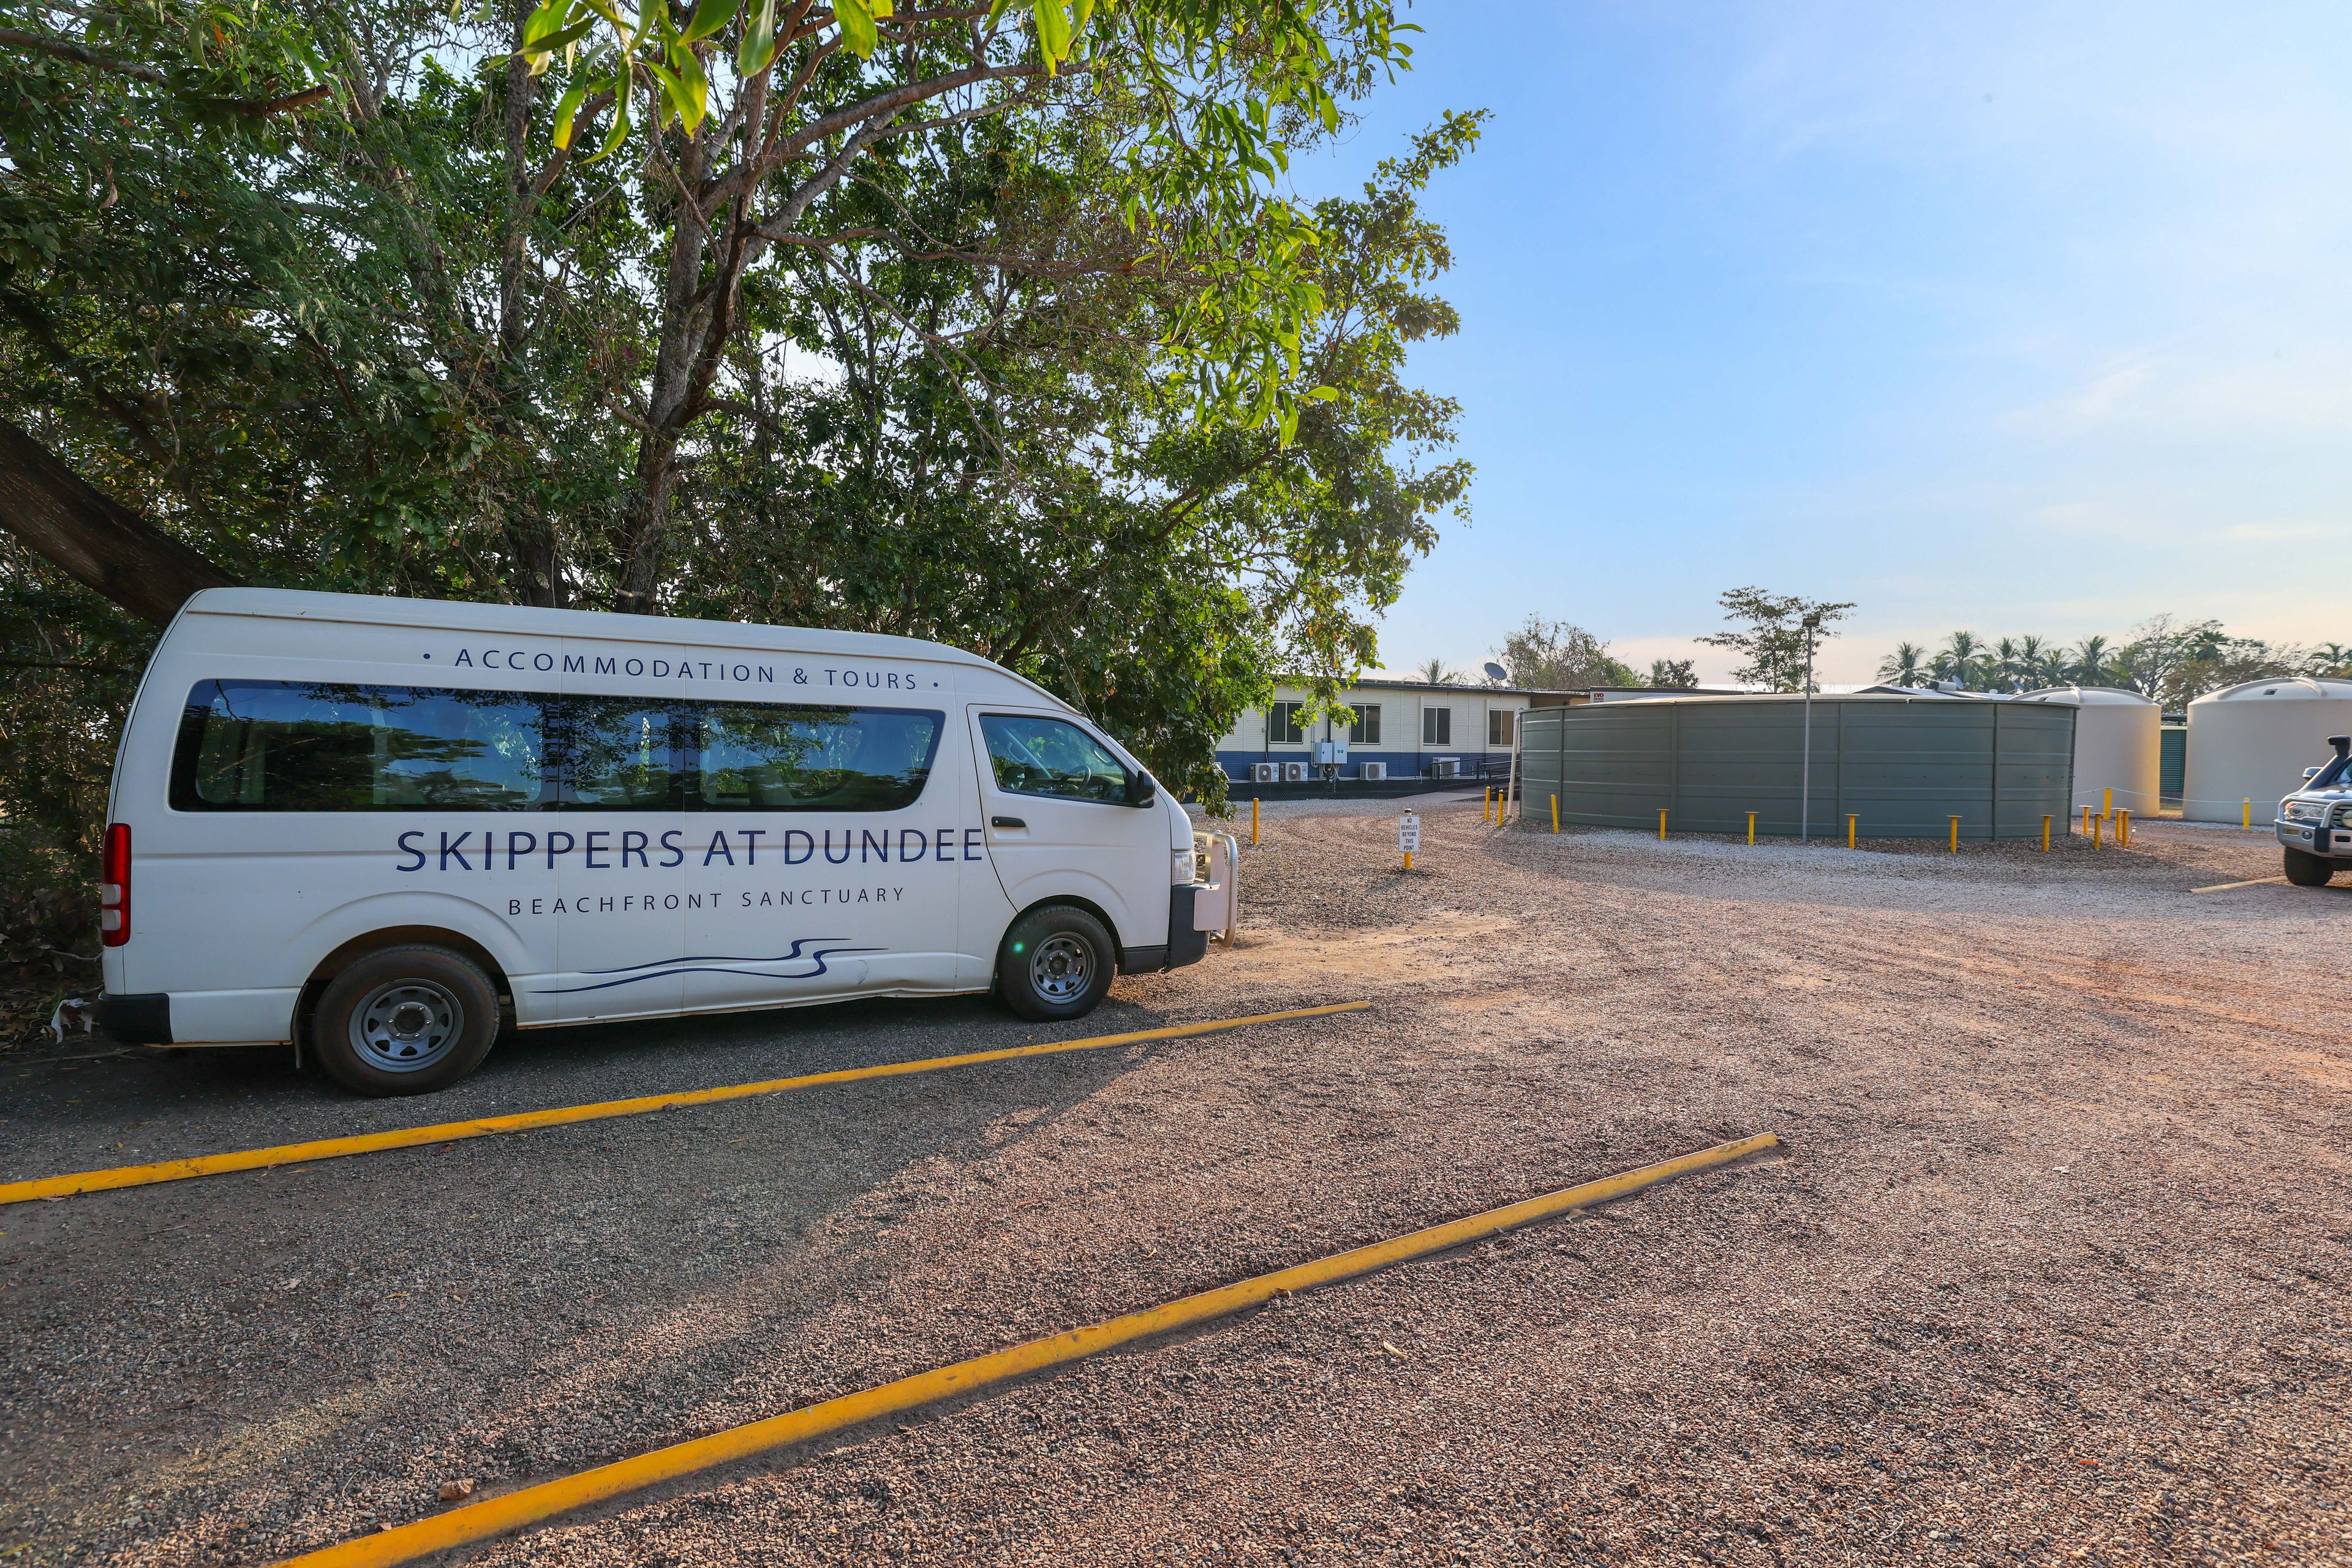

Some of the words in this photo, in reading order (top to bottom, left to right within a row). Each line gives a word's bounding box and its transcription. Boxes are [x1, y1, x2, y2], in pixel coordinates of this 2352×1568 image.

[454, 648, 774, 684] ACCOMMODATION
[793, 668, 809, 685] &
[824, 669, 916, 690] TOURS
[396, 829, 684, 873] SKIPPERS
[703, 830, 766, 867] AT
[784, 827, 982, 865] DUNDEE
[508, 892, 722, 916] BEACHFRONT
[741, 887, 904, 908] SANCTUARY
